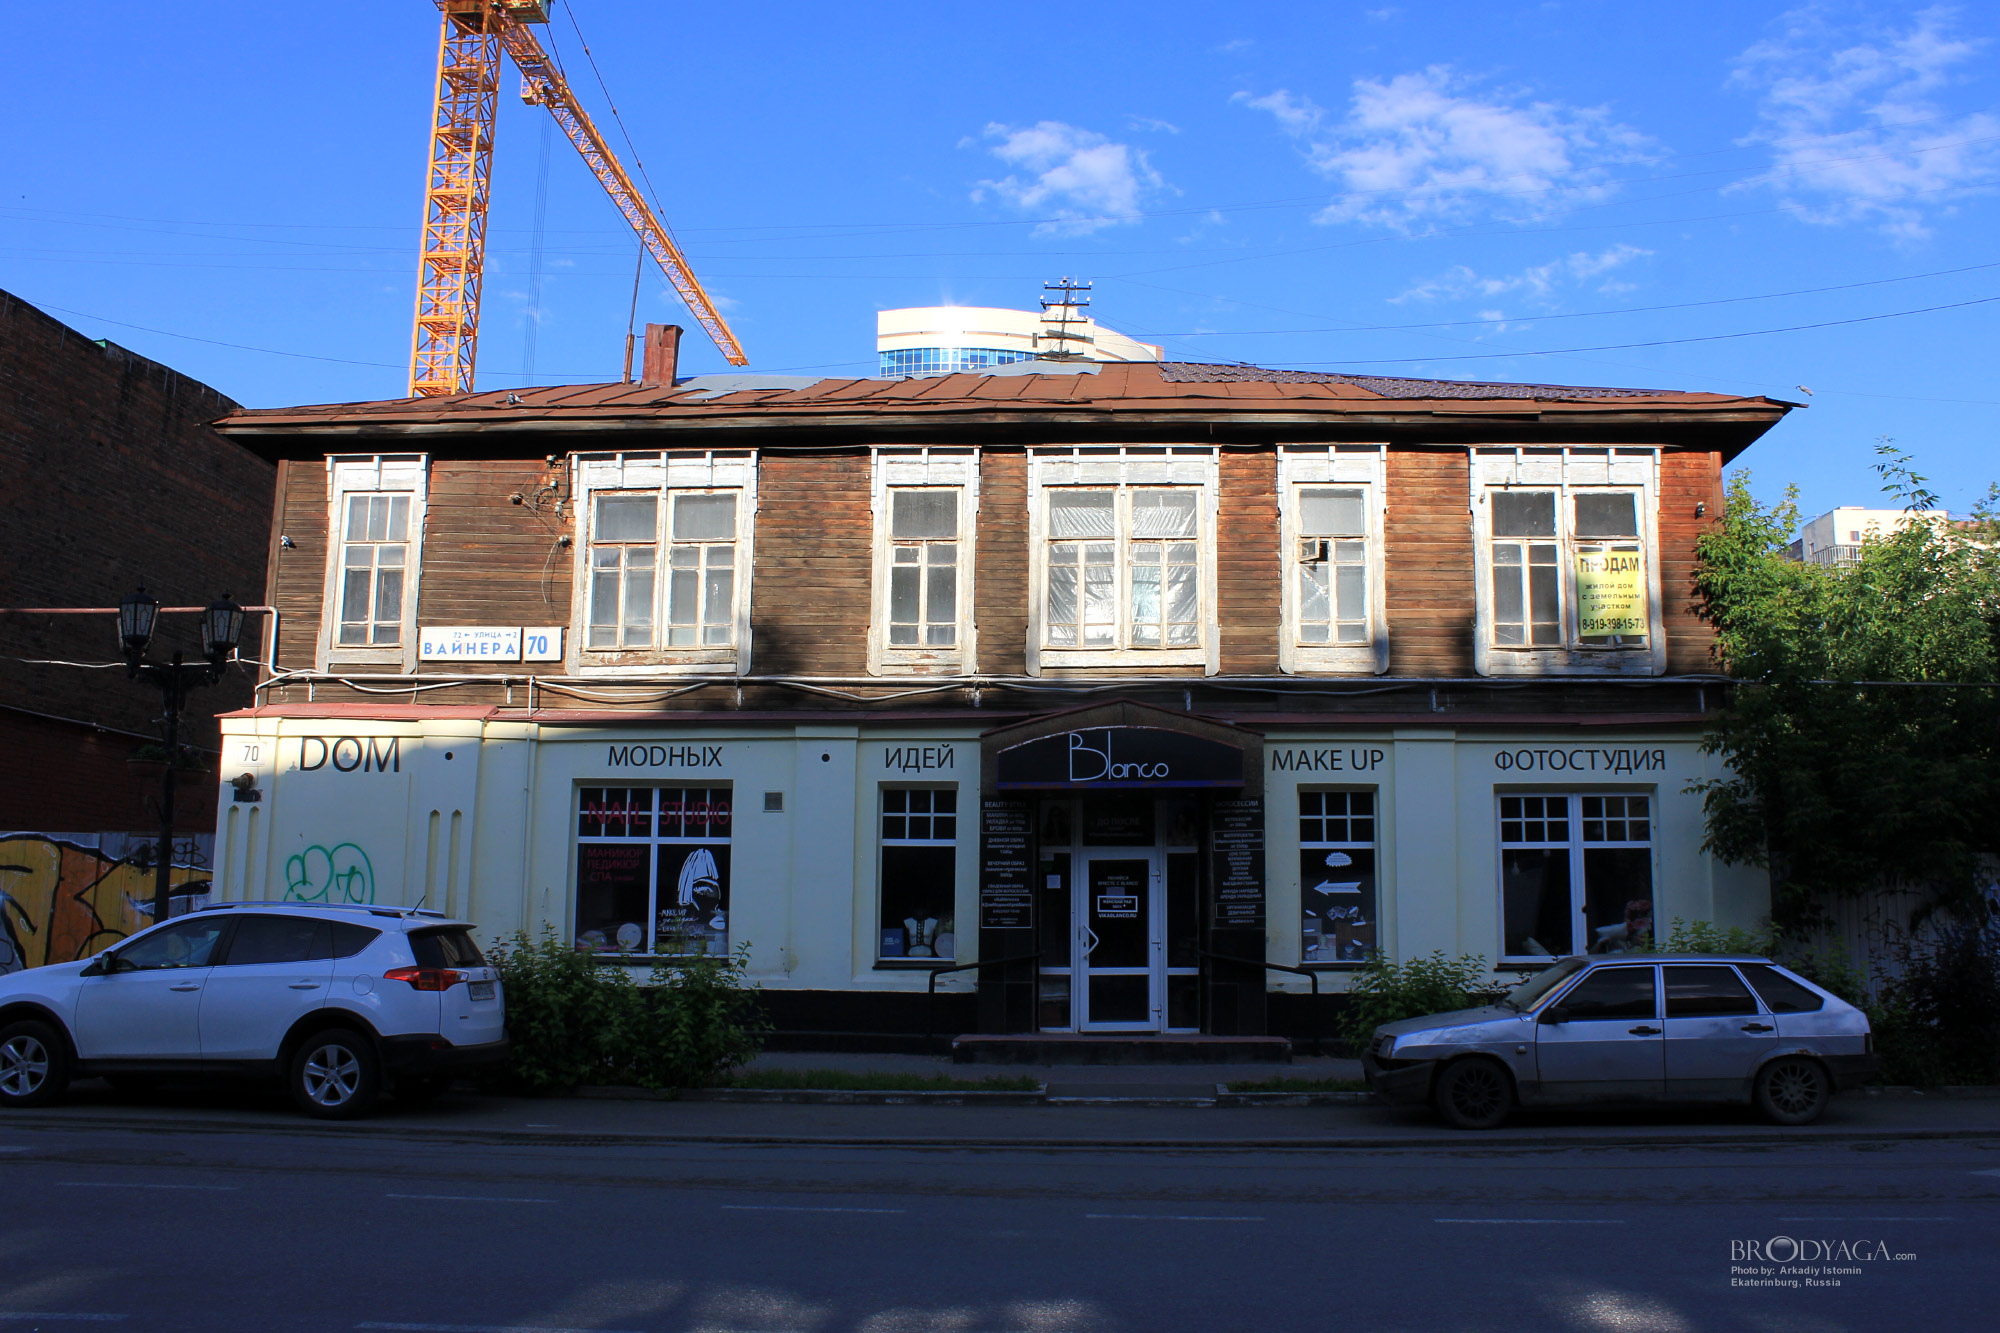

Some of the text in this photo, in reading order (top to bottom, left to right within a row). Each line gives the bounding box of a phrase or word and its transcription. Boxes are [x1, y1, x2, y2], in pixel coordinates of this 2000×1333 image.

[474, 631, 502, 639] УЛИЦА
[423, 639, 516, 655] ВАЙНЕРА
[527, 635, 548, 655] 70
[243, 745, 260, 762] 70
[884, 744, 954, 773] ИДЕЙ
[1069, 730, 1169, 782] Blanco
[1271, 749, 1384, 771] MAKE UP
[1494, 750, 1666, 775] ФОТОСТУДИЯ
[587, 801, 731, 825] NAIL STUDIO
[587, 848, 644, 858] МАНИКЮР
[586, 859, 640, 870] ПЕДИКЮР
[590, 871, 613, 881] СПА
